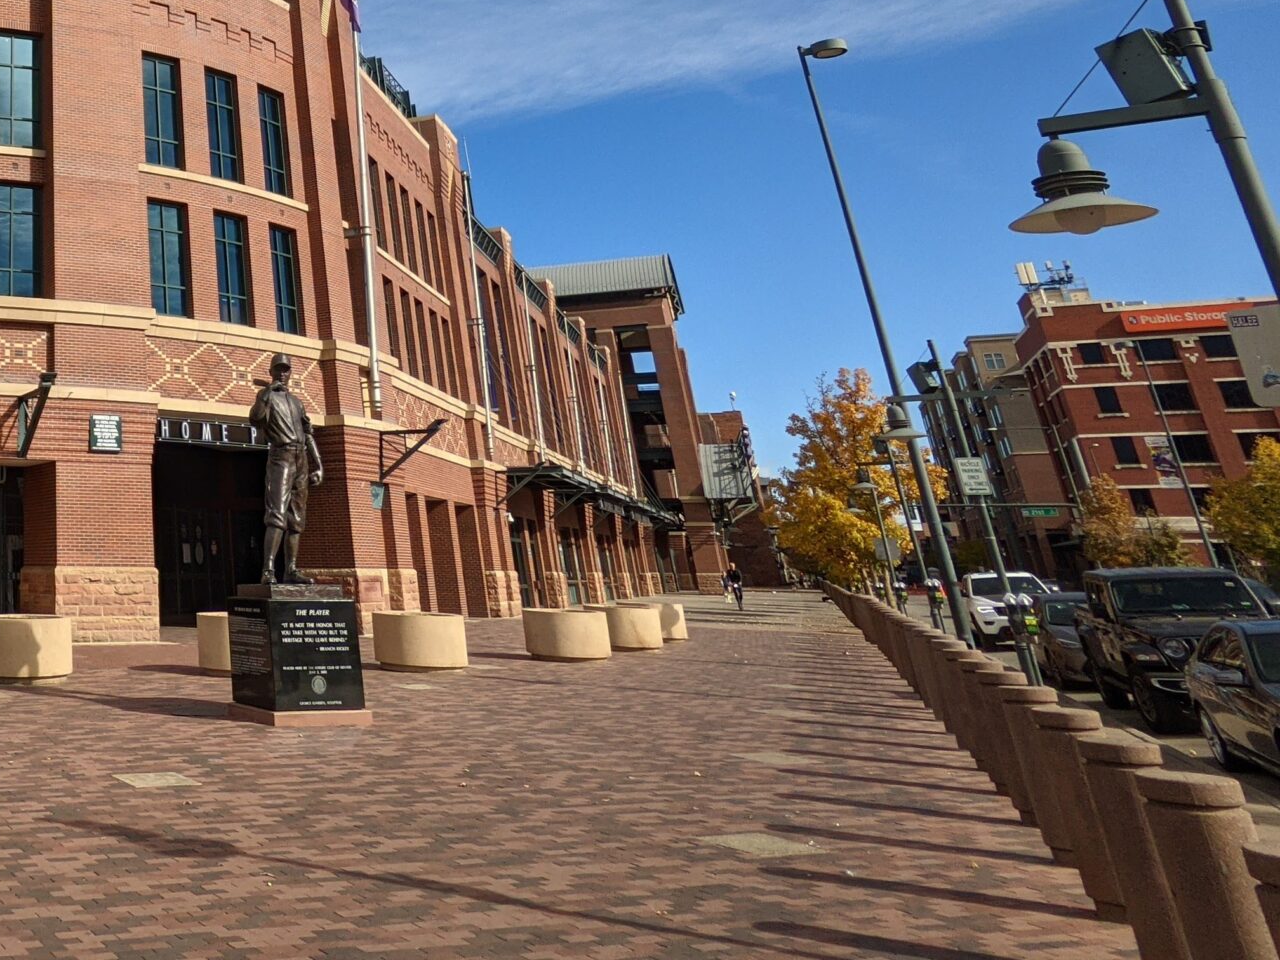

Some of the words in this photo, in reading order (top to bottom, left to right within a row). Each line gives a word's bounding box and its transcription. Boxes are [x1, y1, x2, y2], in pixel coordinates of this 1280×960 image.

[1140, 312, 1183, 325] Public
[1184, 311, 1228, 323] Storag
[161, 419, 229, 442] HOME
